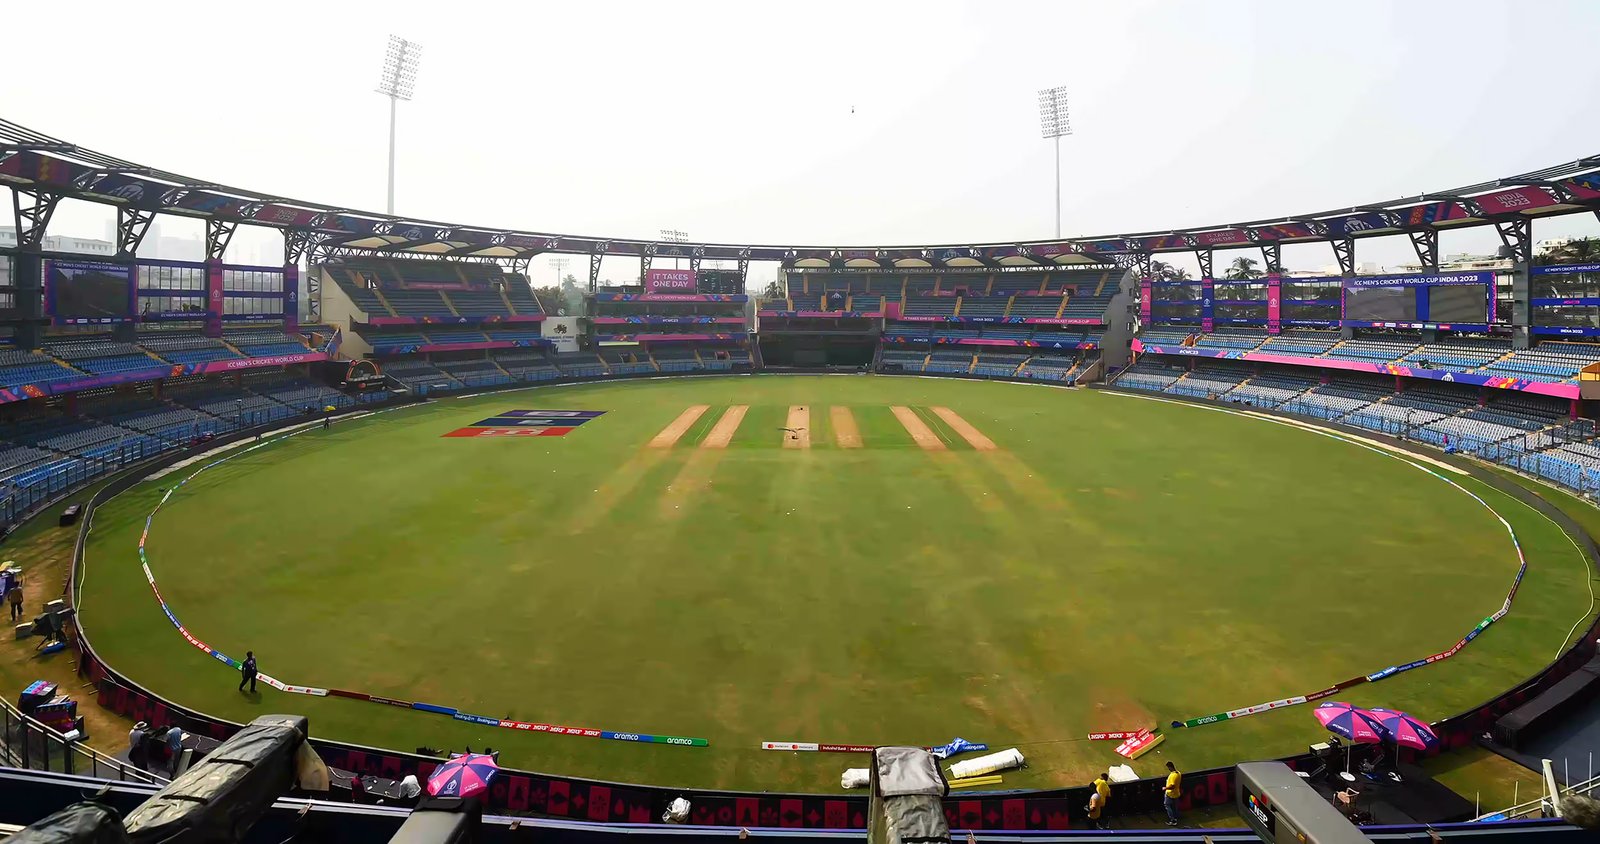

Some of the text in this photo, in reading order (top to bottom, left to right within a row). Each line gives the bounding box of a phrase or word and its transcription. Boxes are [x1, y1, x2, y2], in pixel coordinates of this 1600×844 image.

[1495, 192, 1525, 202] INDIA
[1501, 198, 1531, 208] 2023
[662, 273, 689, 281] TAKES
[653, 280, 689, 288] ONE DAY
[1197, 715, 1217, 725] aramco
[614, 733, 639, 741] aramco
[667, 737, 692, 745] aramco
